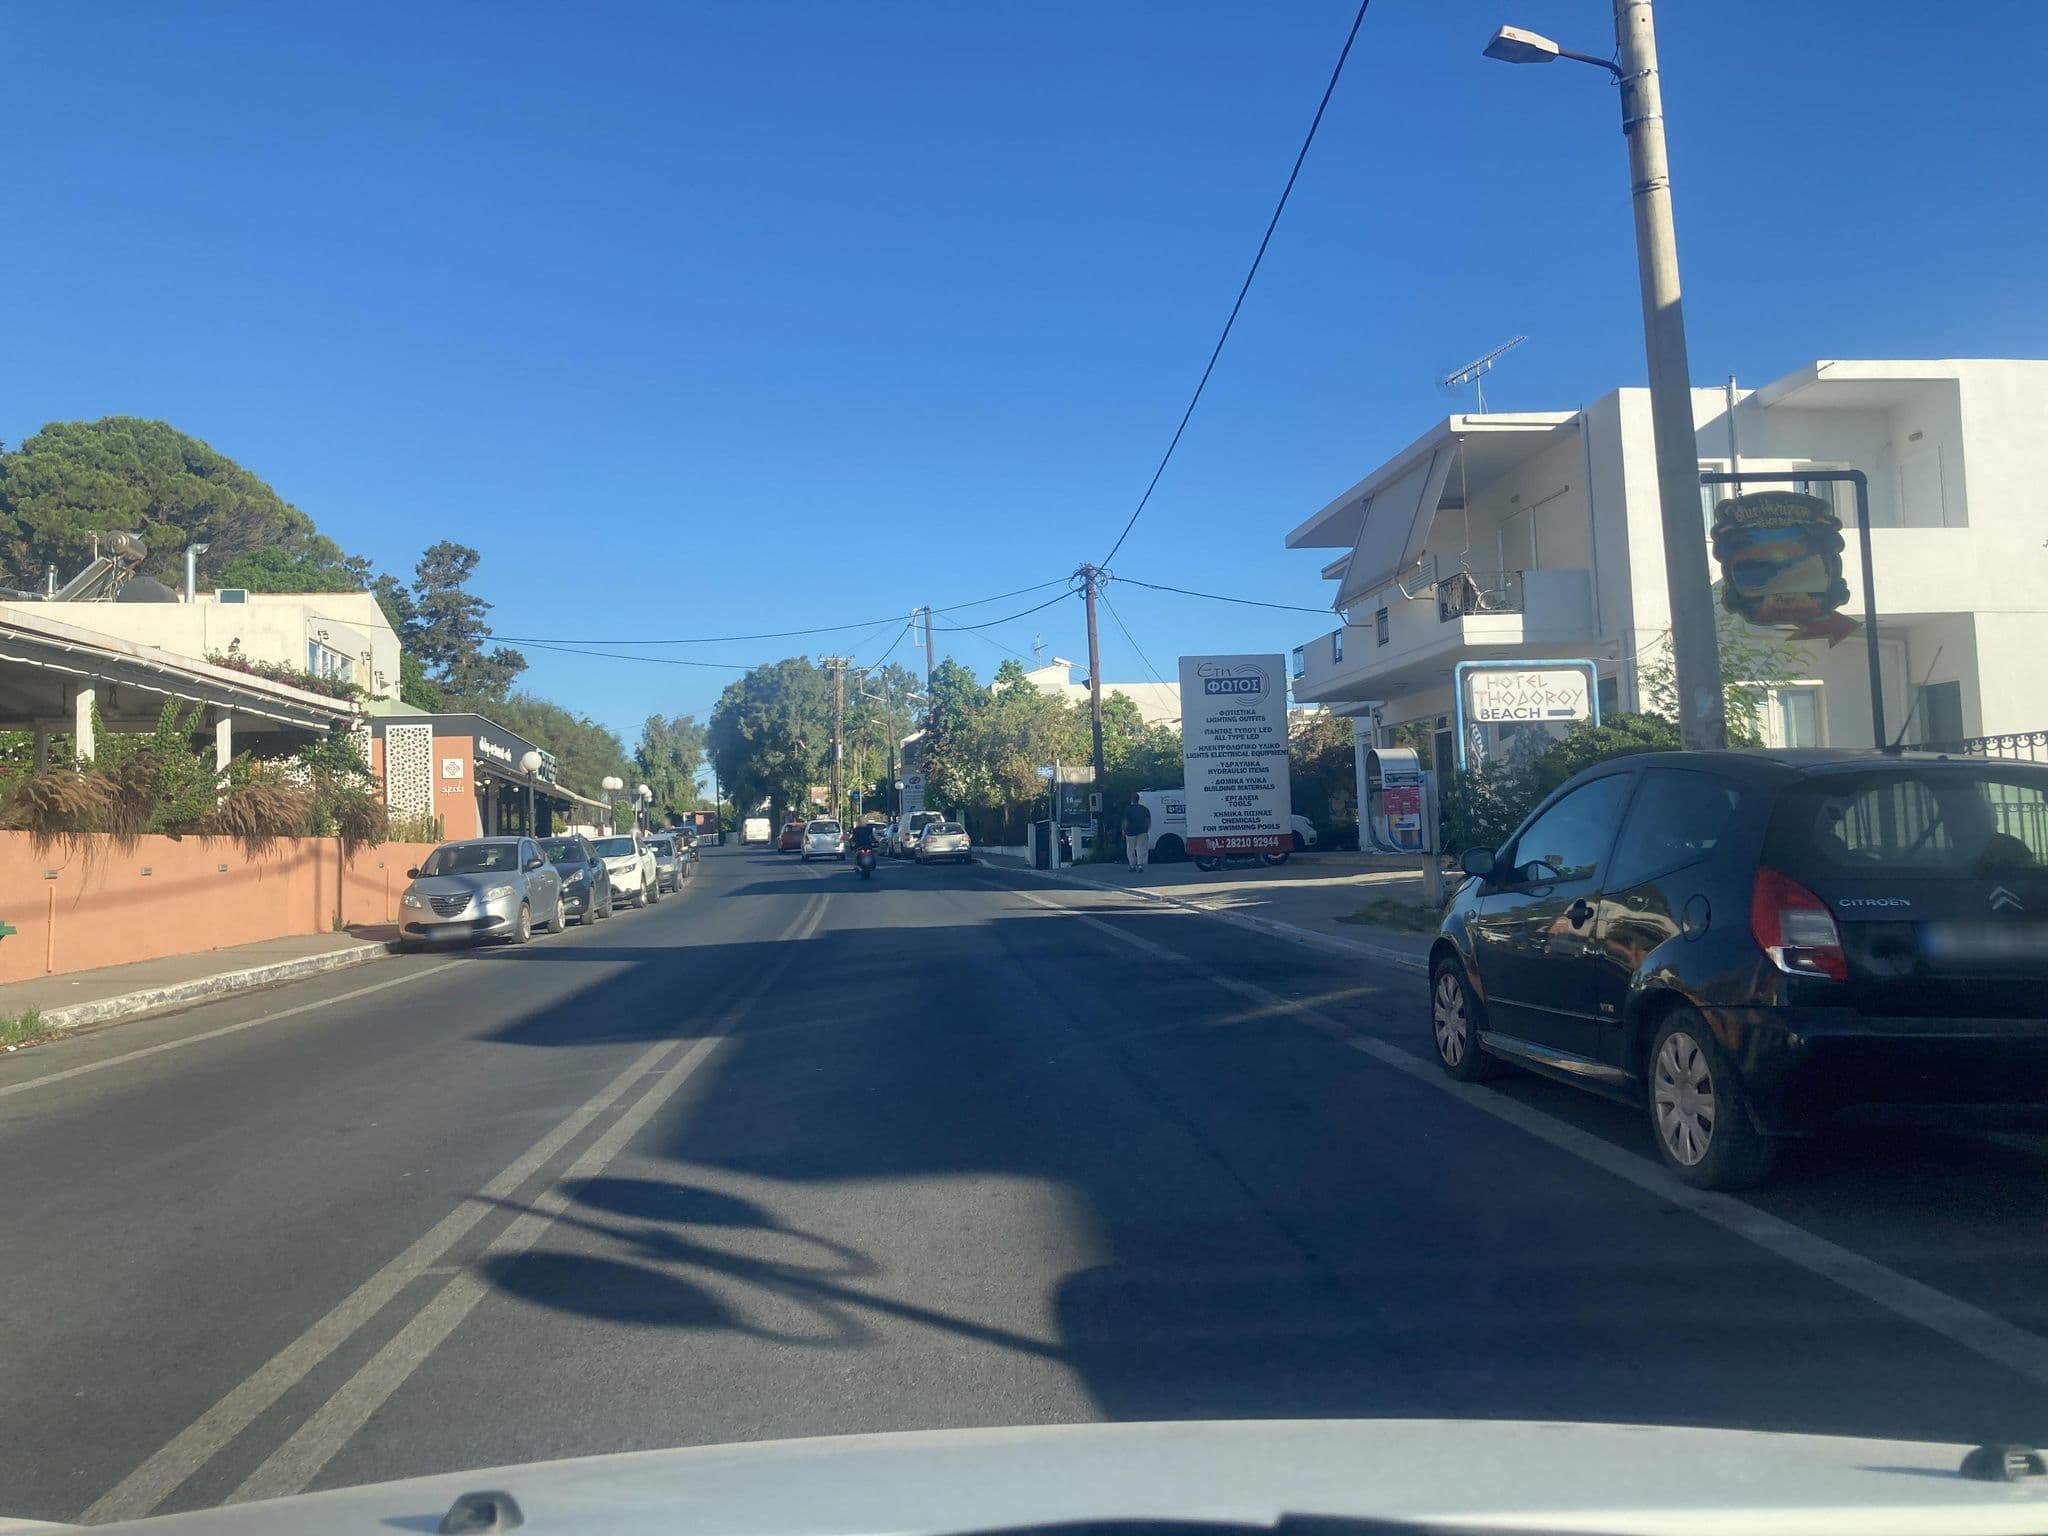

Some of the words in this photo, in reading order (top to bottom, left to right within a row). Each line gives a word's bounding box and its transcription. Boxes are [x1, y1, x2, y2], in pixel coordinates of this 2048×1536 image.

[1207, 679, 1260, 693] ΦΩΤΟΣ
[1486, 674, 1548, 689] HOTEL
[1219, 709, 1257, 717] ΦΩΤΙΣΤΙΚΑ
[1480, 707, 1541, 720] BEACH
[1206, 716, 1238, 724] LIGHTING
[1204, 727, 1232, 735] ΠΑΝΤΟΣ
[1198, 744, 1257, 752] ΗΛΕΚΤΡΟΛΟΓΙΚΟ
[1251, 749, 1289, 757] EQUIPMENT
[1208, 767, 1247, 775] HYDRAULIC
[1249, 766, 1269, 774] ITEMS
[1226, 838, 1251, 849] 28210
[1253, 836, 1279, 847] 92944
[1839, 897, 1911, 907] CITROËN
